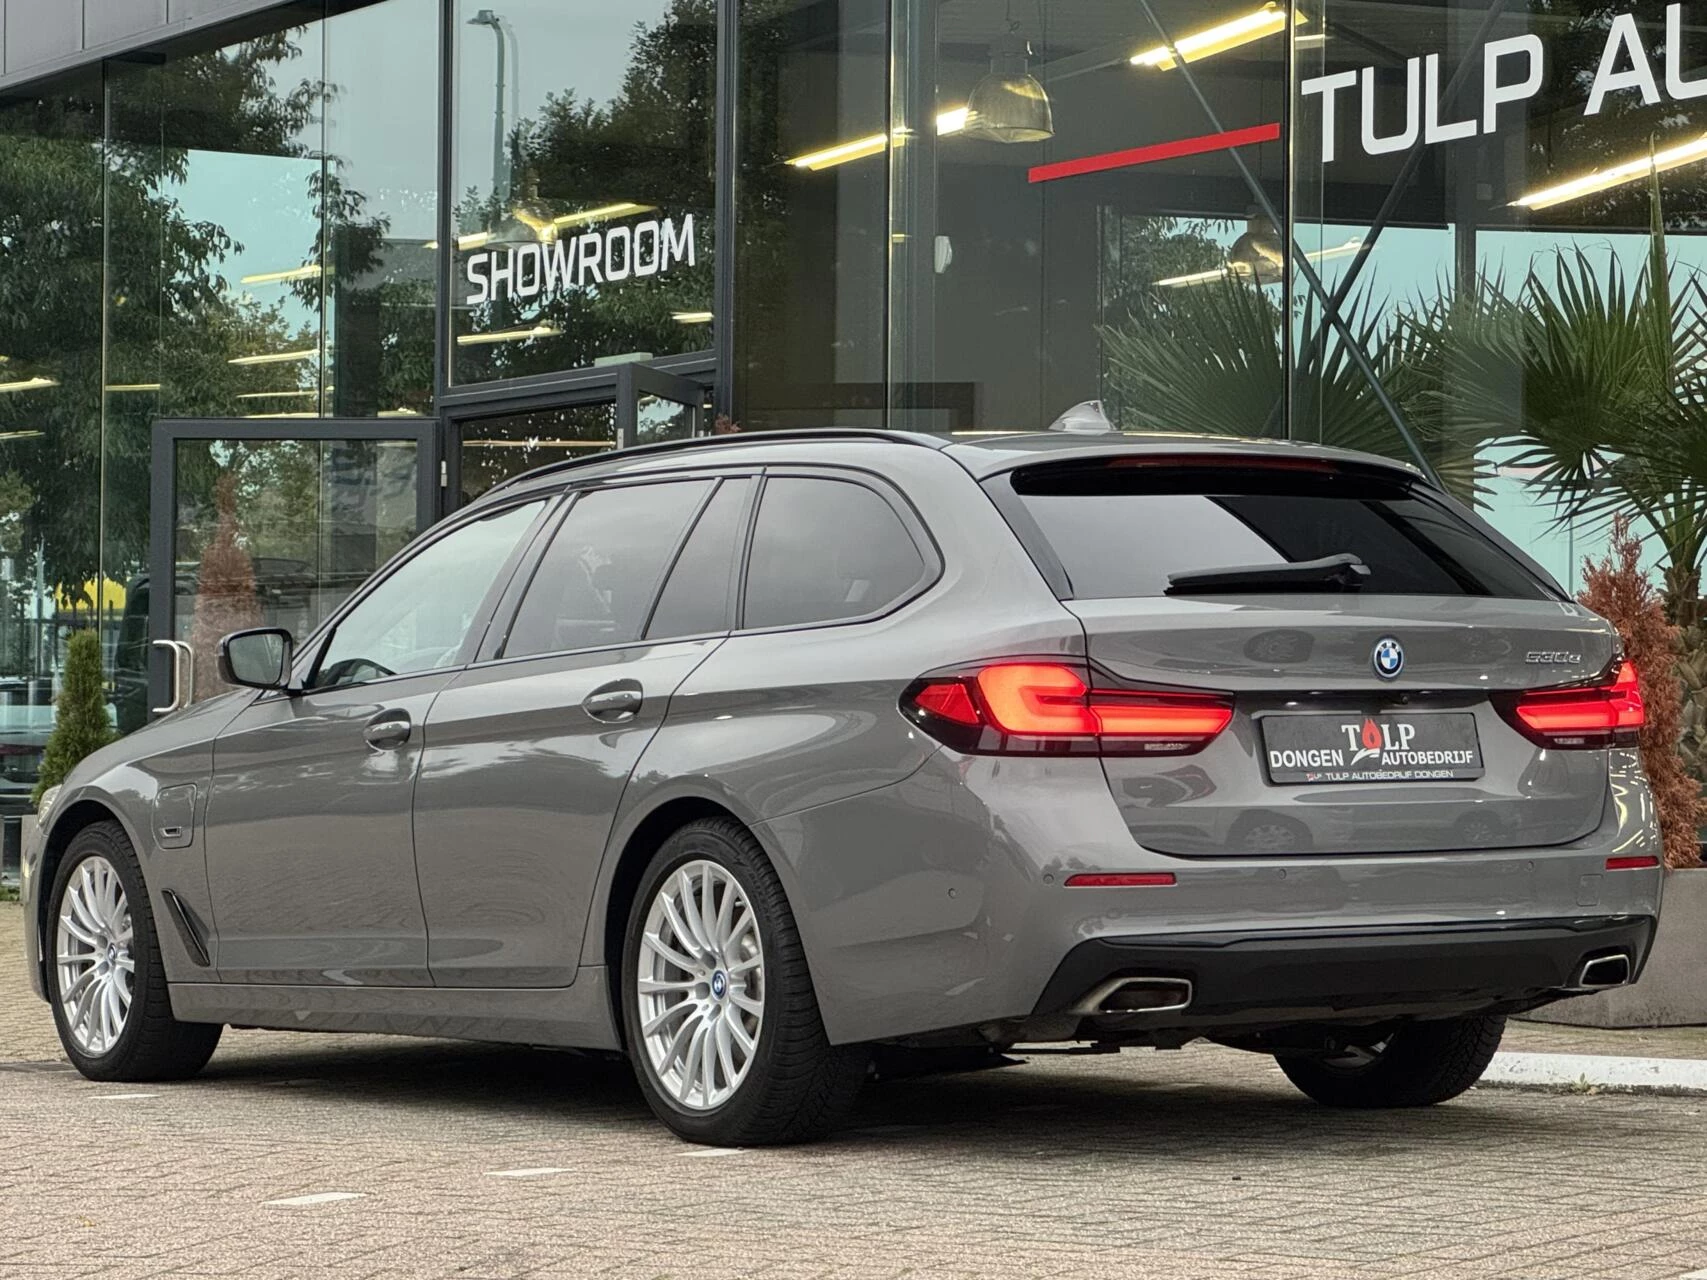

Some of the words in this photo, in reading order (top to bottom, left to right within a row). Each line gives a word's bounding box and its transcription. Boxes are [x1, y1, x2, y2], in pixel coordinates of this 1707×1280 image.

[1301, 33, 1544, 163] TULP
[466, 213, 696, 305] SHOWROOM
[1525, 651, 1581, 664] 530e
[1270, 749, 1344, 768] DONGEN
[1381, 750, 1473, 766] AUTOBEDRIJF
[1325, 772, 1350, 781] TULP
[1414, 769, 1454, 778] DONGEN
